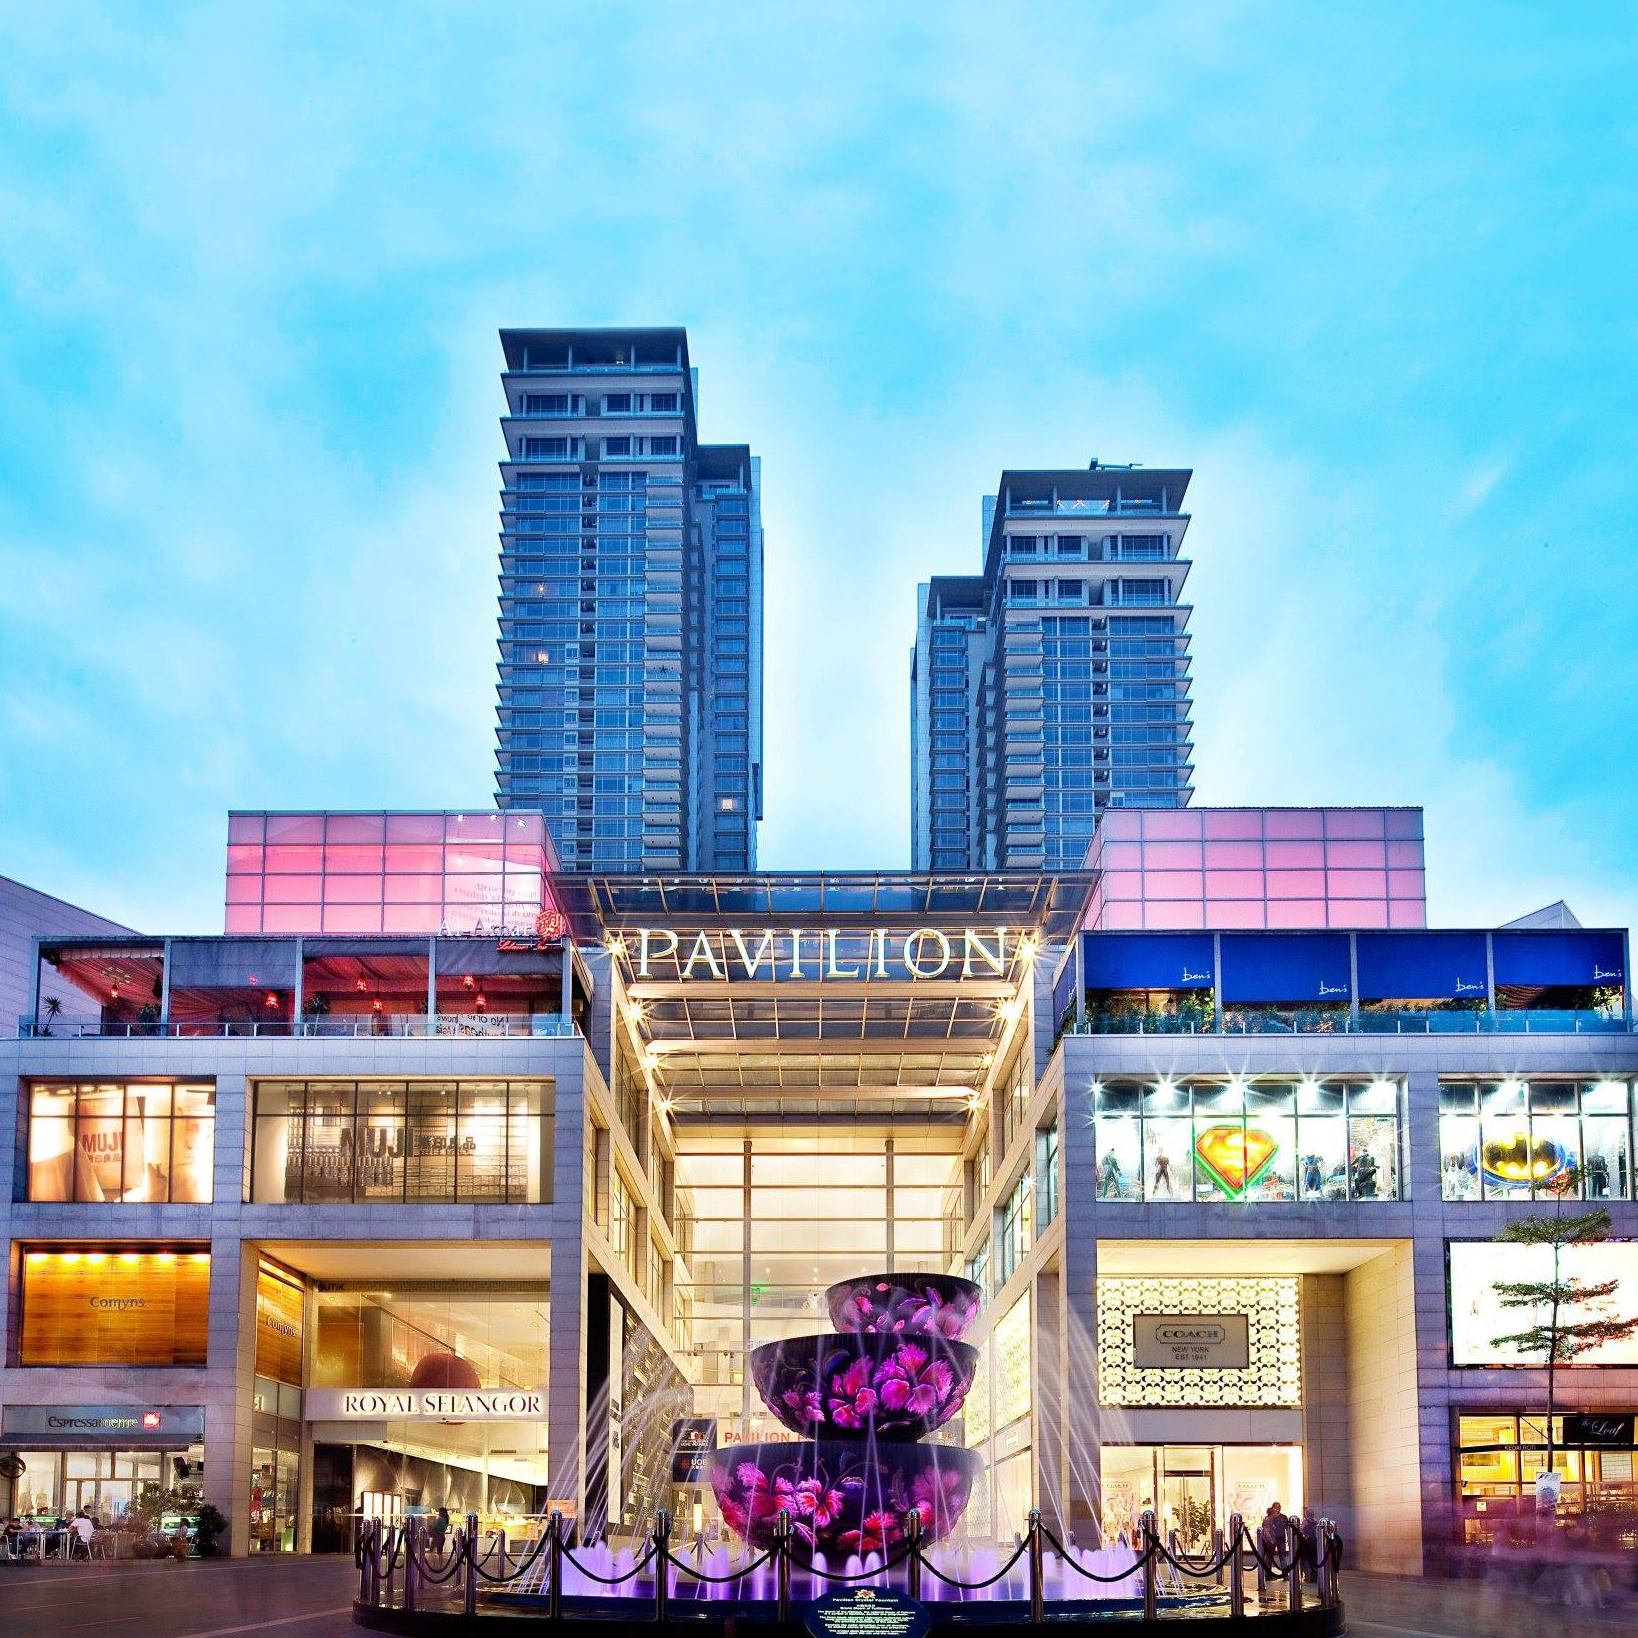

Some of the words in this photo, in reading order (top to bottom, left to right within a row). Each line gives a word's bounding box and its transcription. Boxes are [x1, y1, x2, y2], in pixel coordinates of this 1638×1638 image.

[636, 927, 1008, 979] PAVILION
[340, 1128, 414, 1158] MUJI
[90, 1296, 145, 1311] Comyns
[266, 1315, 296, 1338] Comyns
[1162, 1329, 1218, 1338] COACH
[345, 1394, 418, 1413] ROYAL
[425, 1394, 541, 1414] SELANGOR
[1591, 1421, 1625, 1437] Loaf
